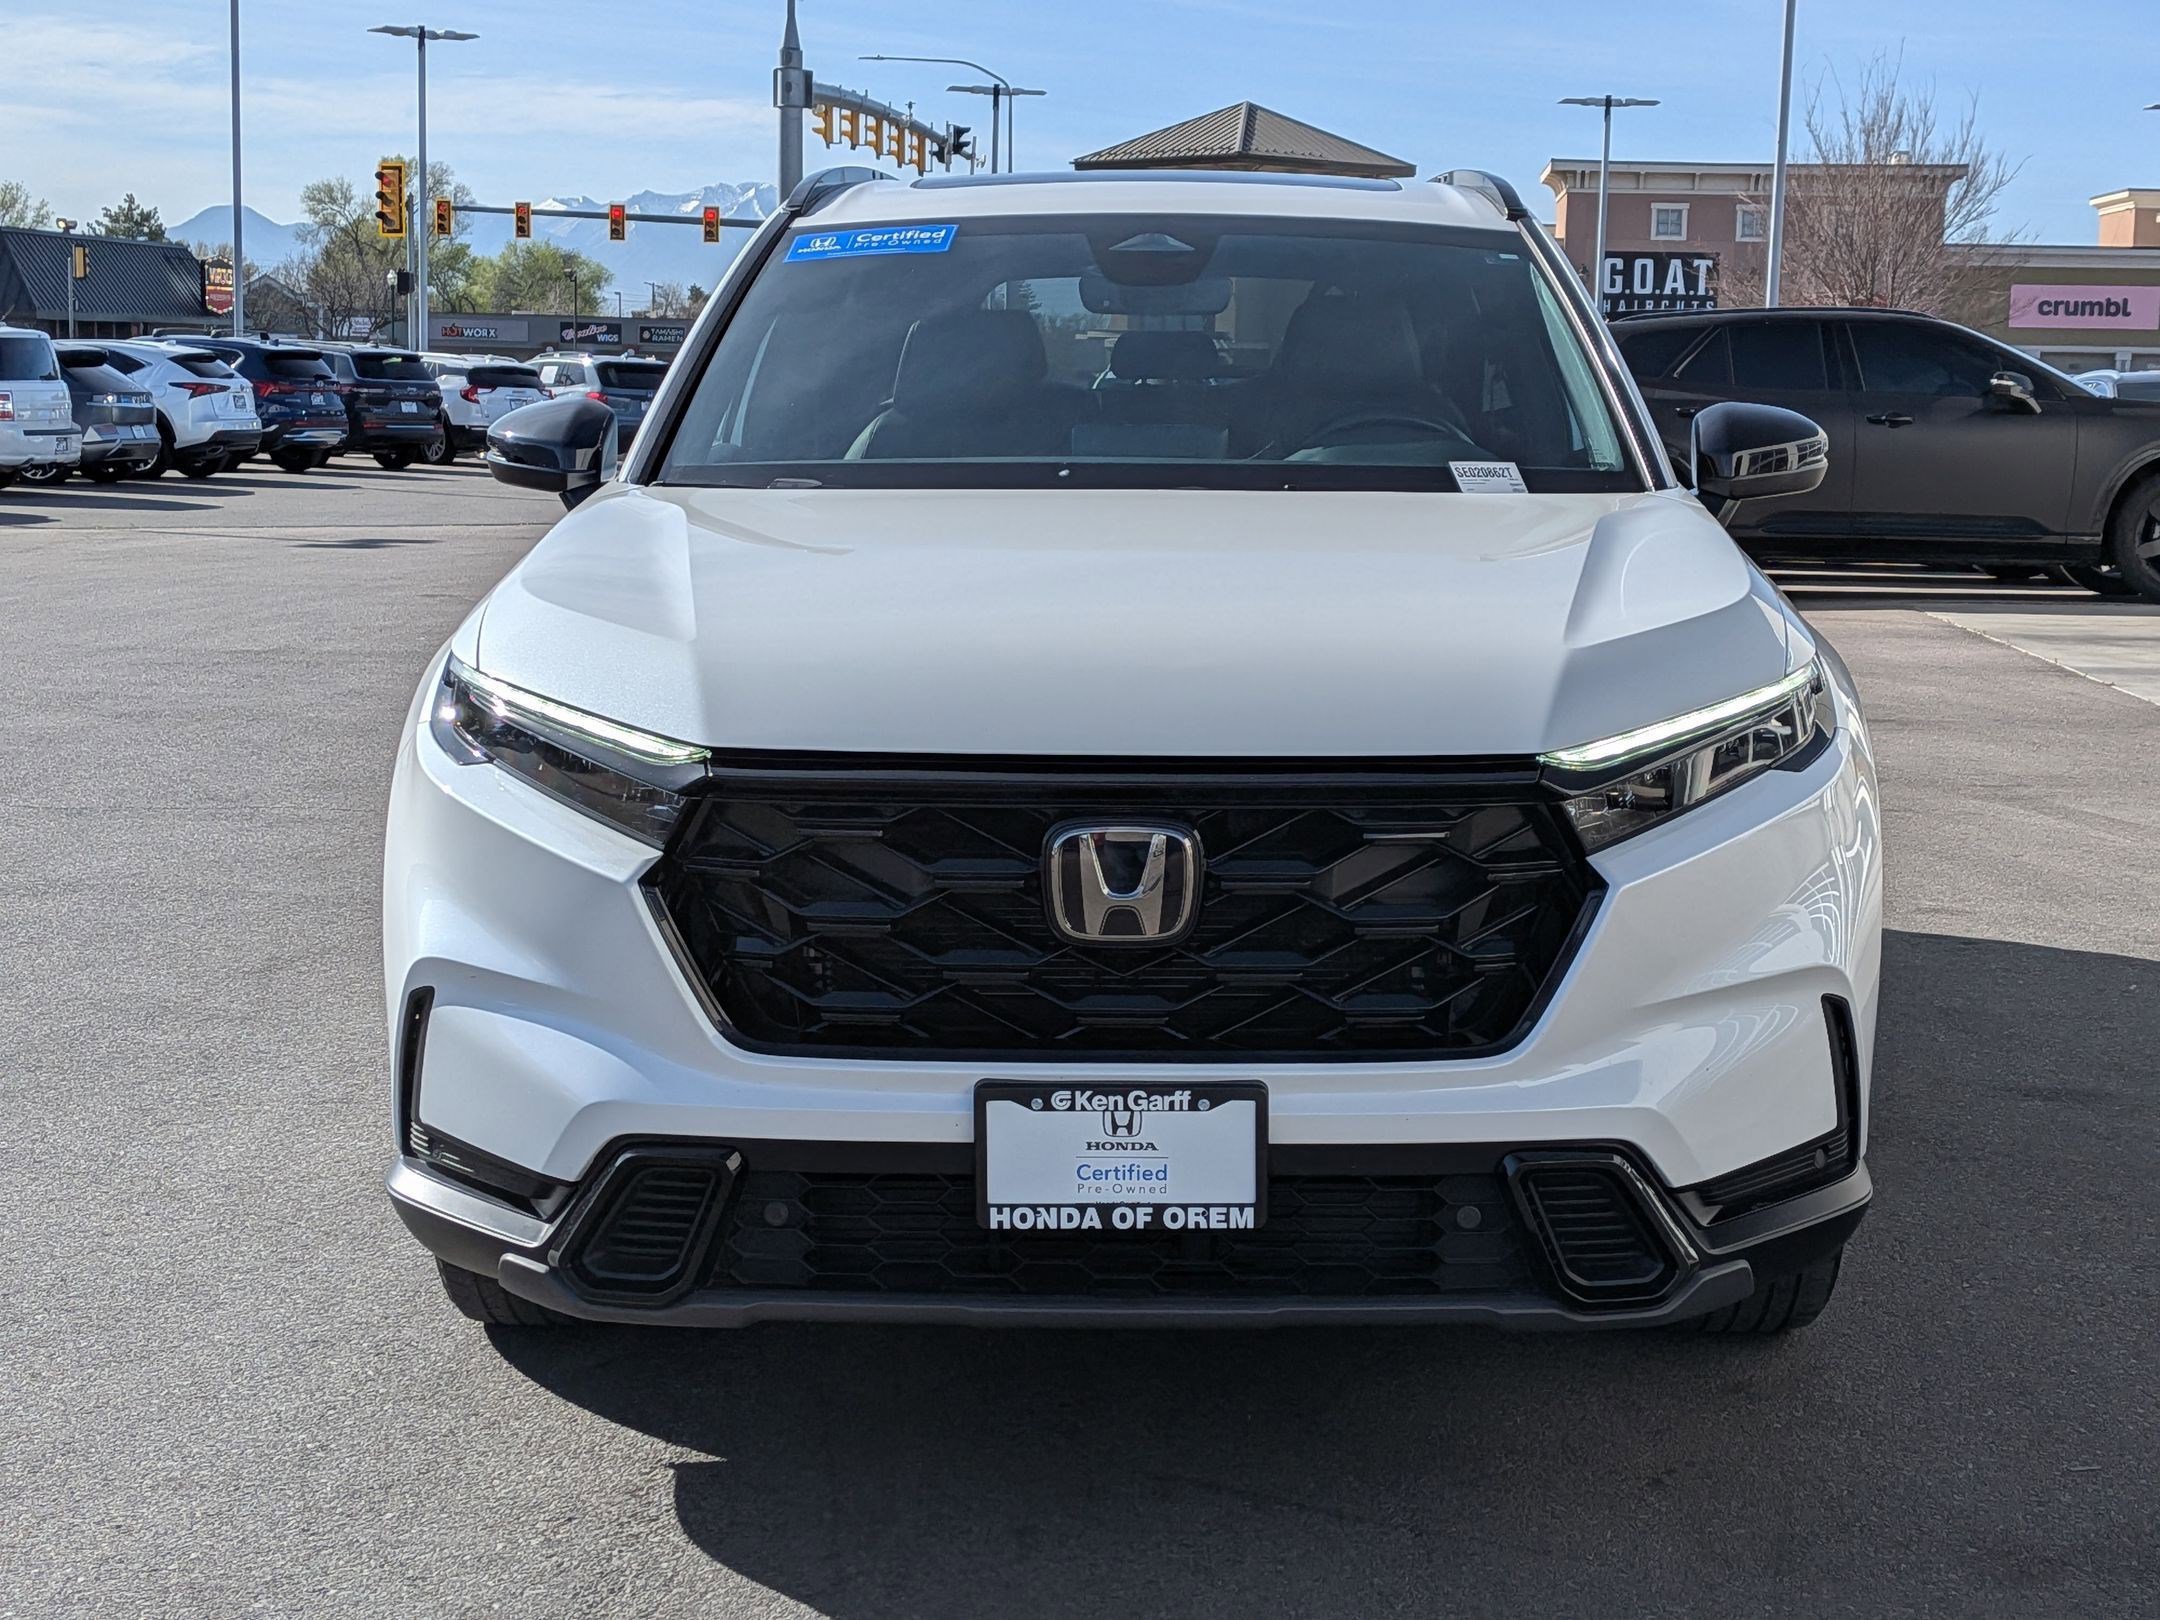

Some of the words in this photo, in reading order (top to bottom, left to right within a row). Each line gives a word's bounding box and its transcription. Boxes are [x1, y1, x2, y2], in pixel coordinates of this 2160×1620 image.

[856, 229, 946, 243] Certified
[853, 238, 942, 248] Pre-Owned
[1603, 299, 1715, 312] HAIRCUTS
[2037, 297, 2132, 317] crumbl
[596, 333, 619, 342] WIGS
[652, 334, 684, 342] RAMEN
[1074, 1090, 1124, 1111] Ken
[1127, 1090, 1192, 1111] Garff
[1086, 1141, 1159, 1151] HONDA
[1076, 1164, 1168, 1181] Certified
[1077, 1183, 1168, 1194] Pre-Owned
[989, 1207, 1103, 1230] HONDA
[1111, 1207, 1153, 1230] OF
[1163, 1207, 1255, 1230] OREM
